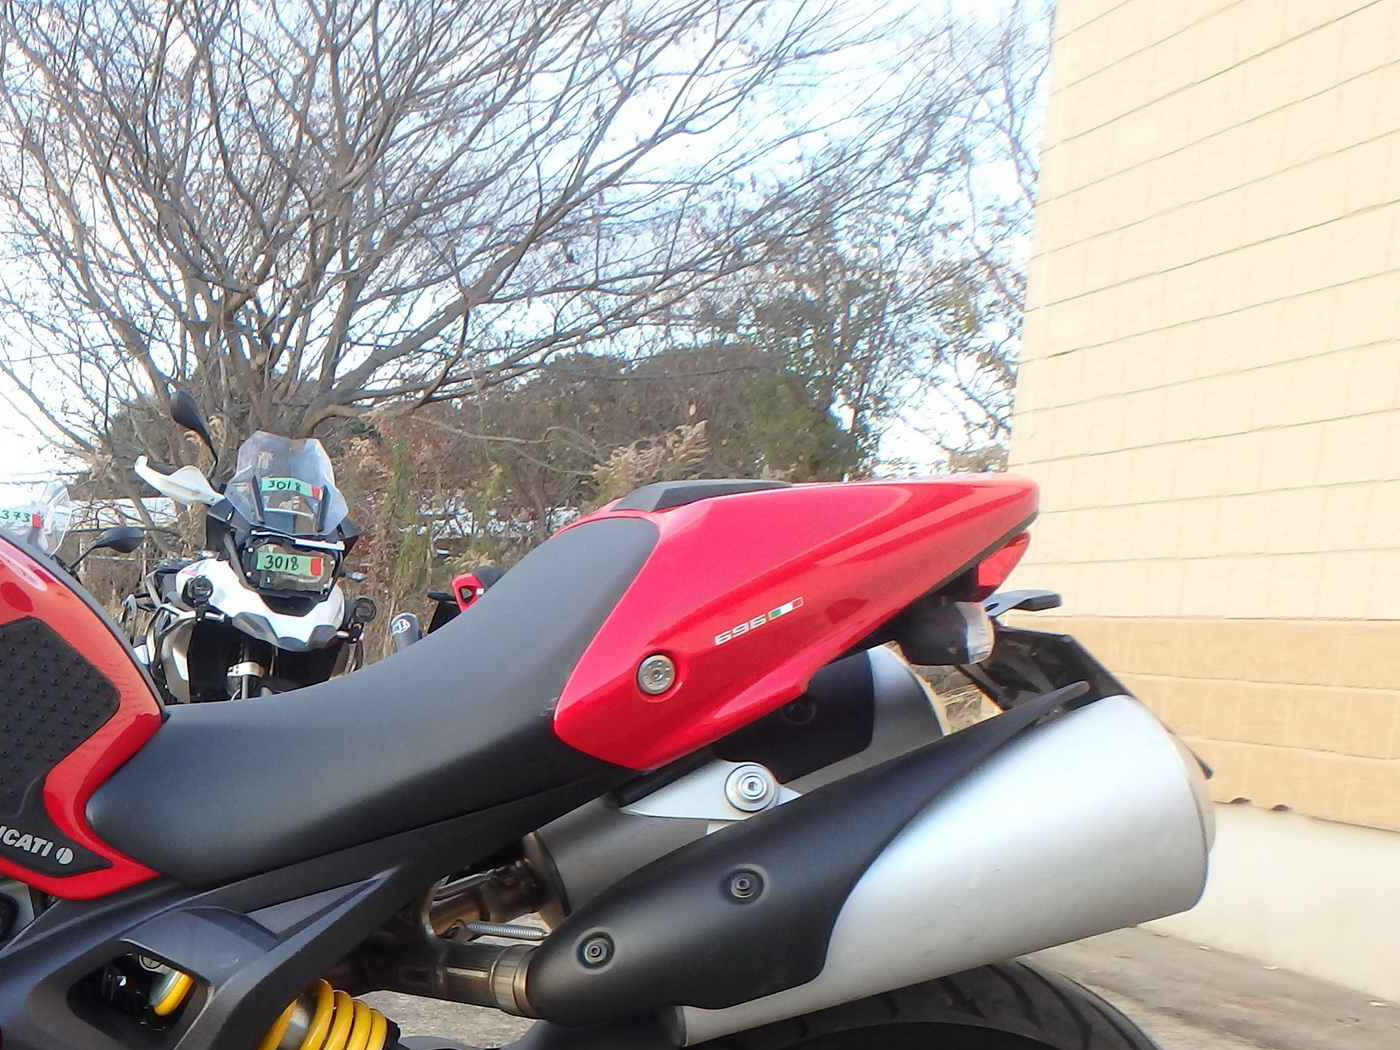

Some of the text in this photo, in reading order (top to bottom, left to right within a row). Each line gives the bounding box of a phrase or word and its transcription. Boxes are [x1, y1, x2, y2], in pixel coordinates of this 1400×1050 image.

[268, 480, 301, 492] 3018
[263, 554, 299, 571] 3018
[713, 612, 767, 646] 696
